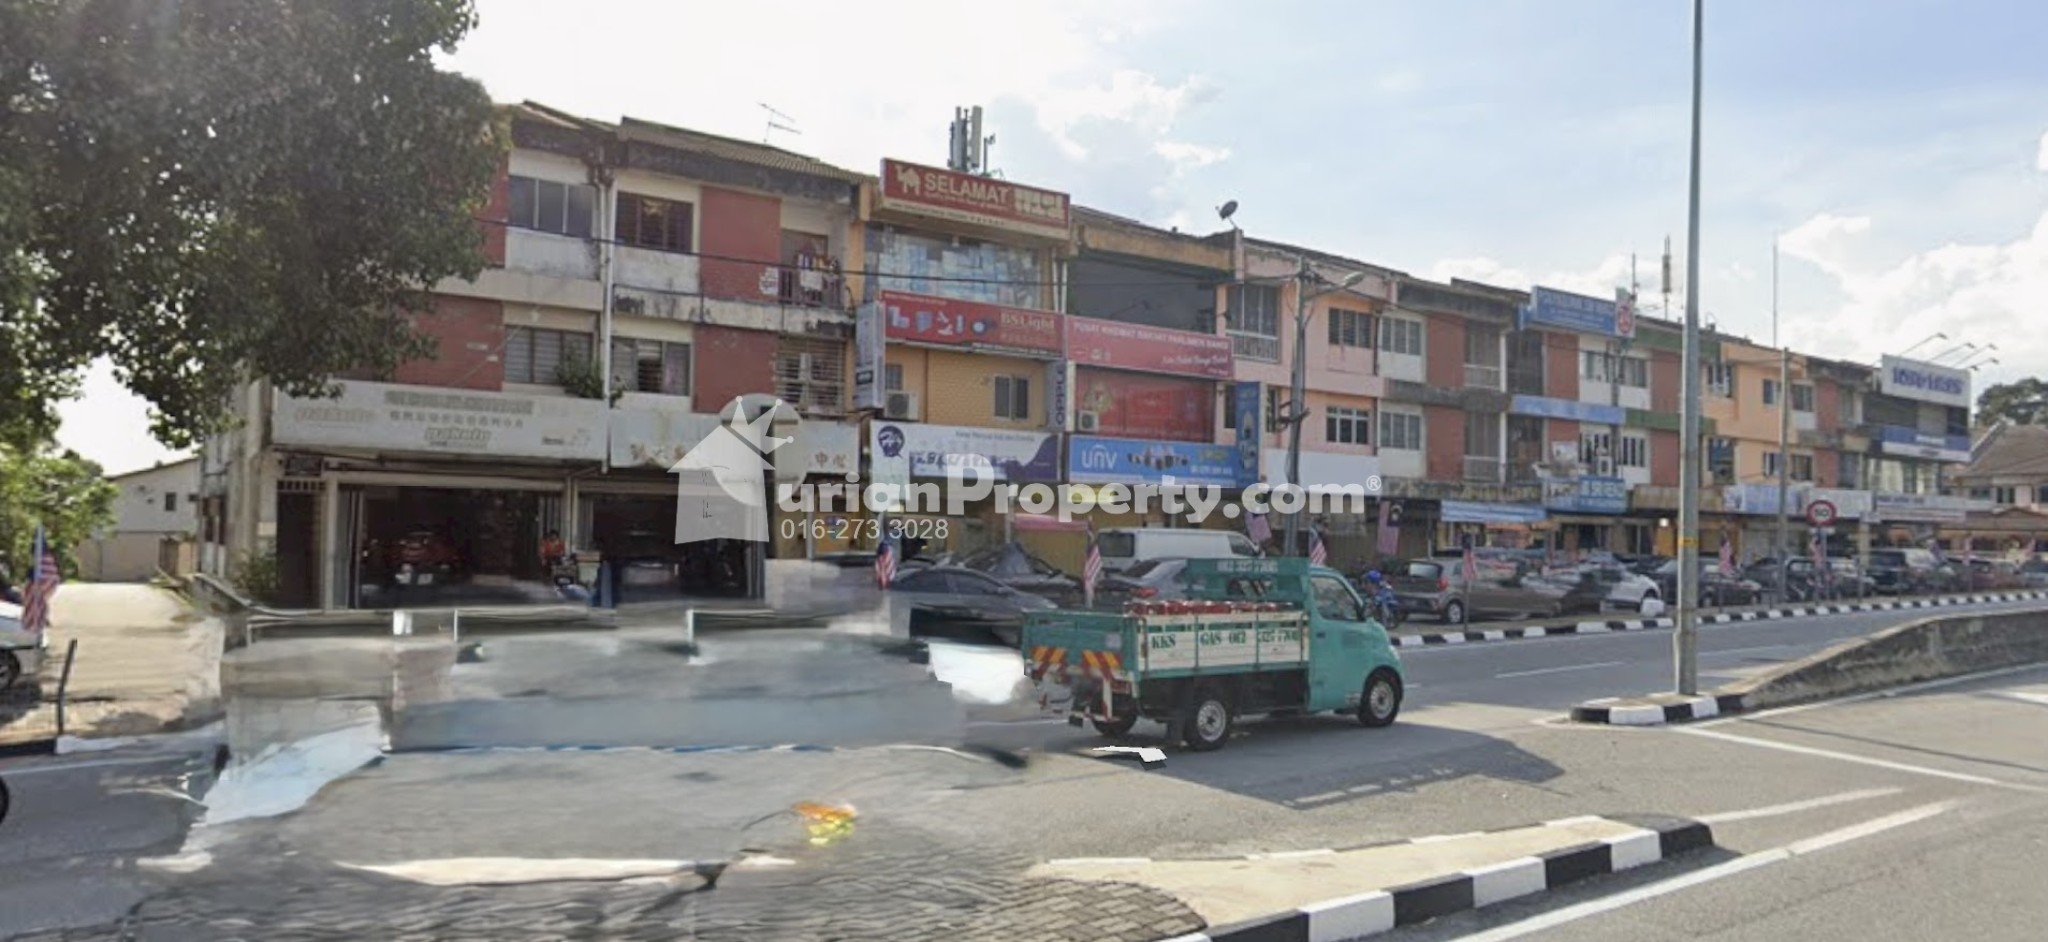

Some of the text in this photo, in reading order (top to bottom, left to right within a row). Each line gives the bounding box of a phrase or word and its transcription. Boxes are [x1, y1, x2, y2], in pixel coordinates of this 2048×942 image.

[924, 173, 1009, 204] SELAMAT
[1152, 633, 1176, 649] KKS
[1201, 631, 1221, 646] GAS
